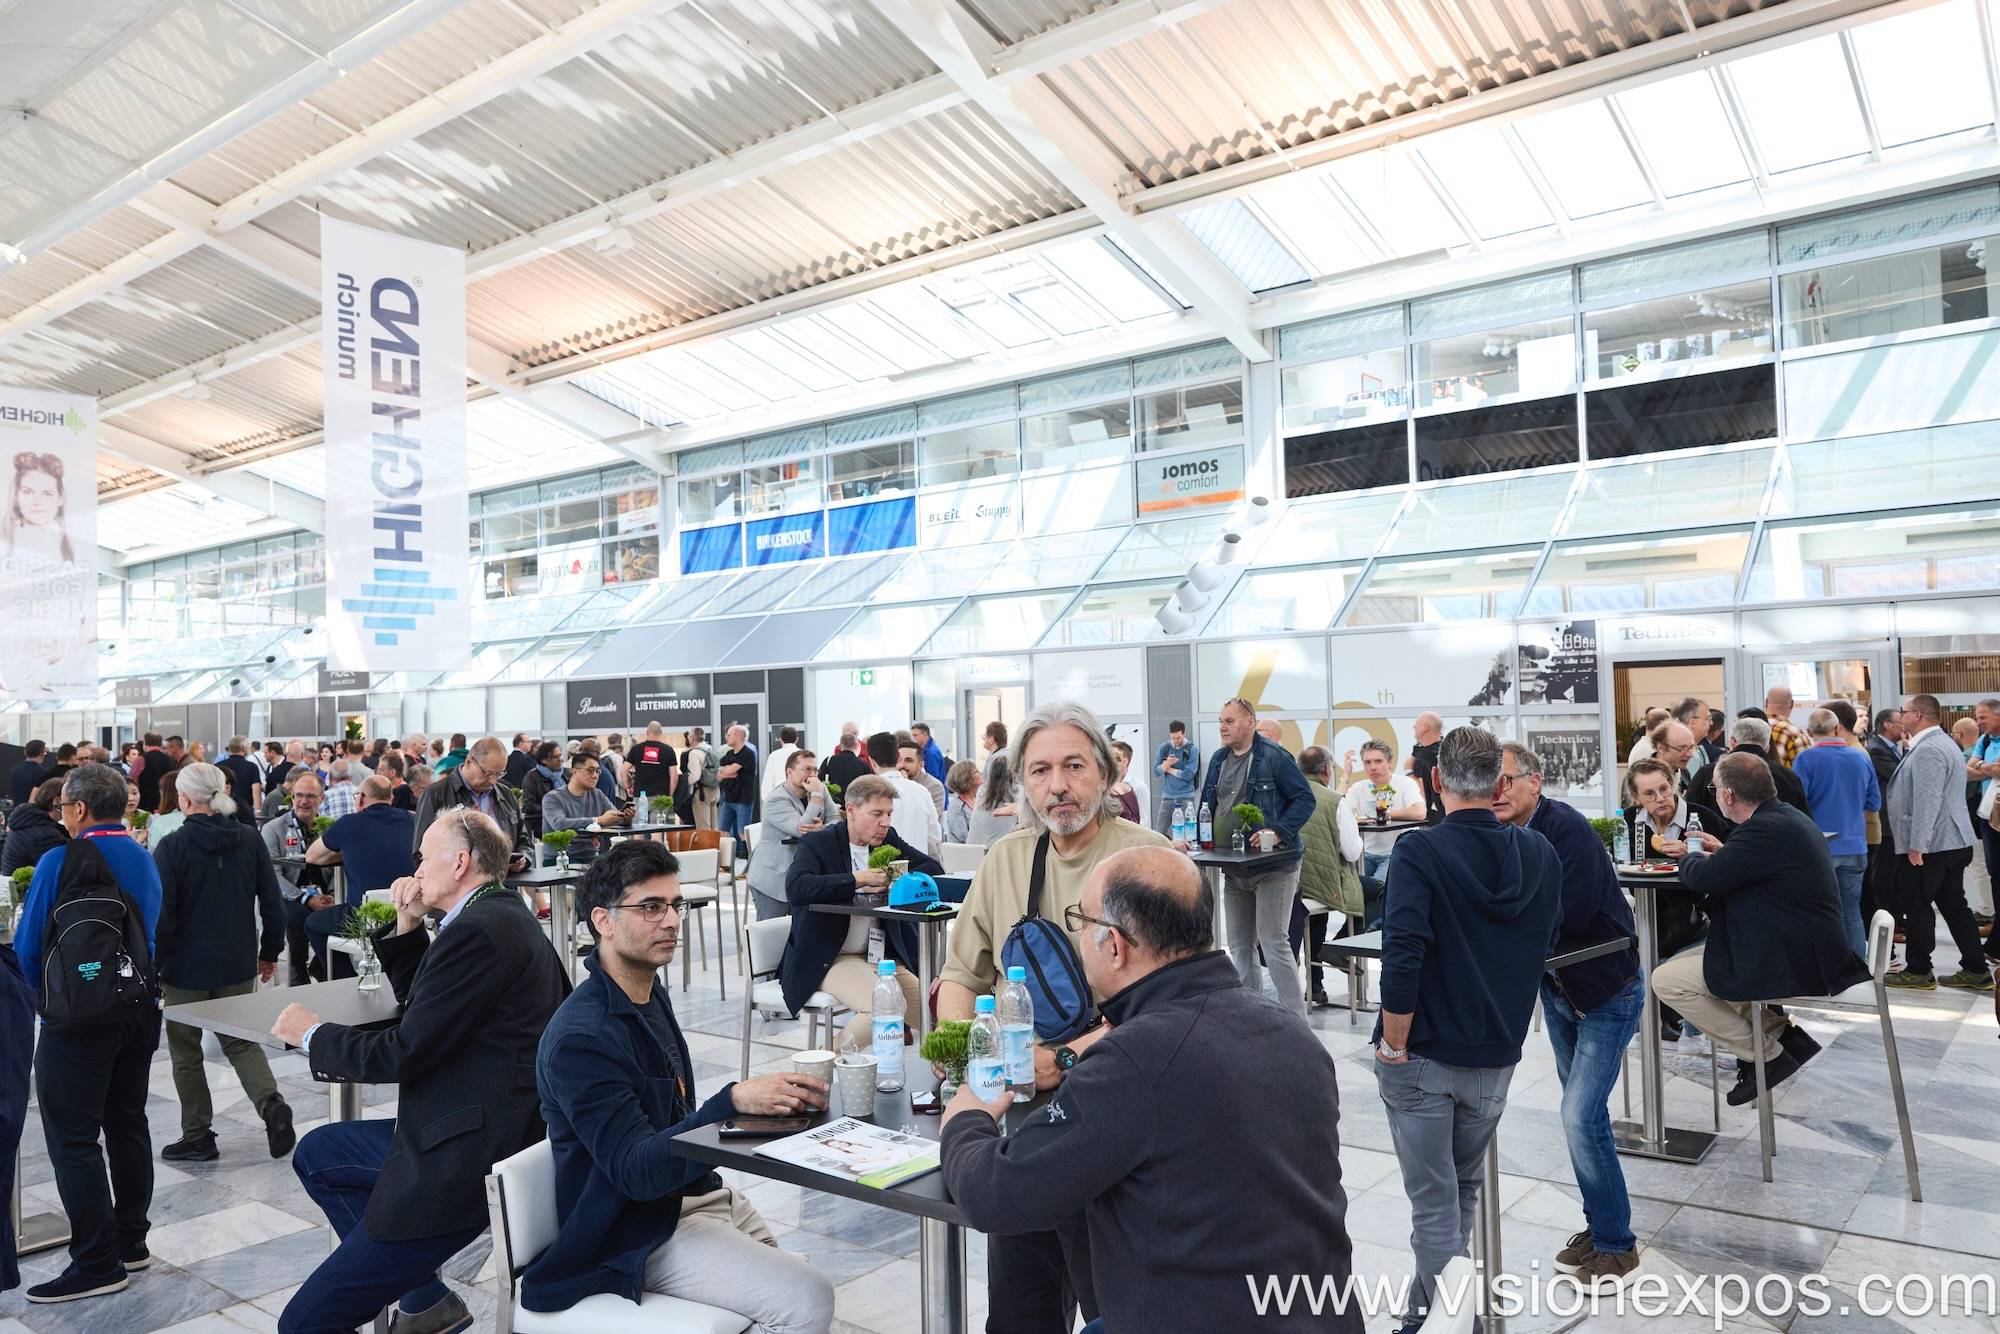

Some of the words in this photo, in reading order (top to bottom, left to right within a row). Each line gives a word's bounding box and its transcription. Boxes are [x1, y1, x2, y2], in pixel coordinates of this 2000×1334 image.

[1177, 473, 1219, 492] comfort
[756, 528, 813, 551] BIRKENSTOCK
[1618, 624, 1717, 641] Technics
[117, 687, 149, 697] MOON
[1377, 688, 1395, 705] th
[577, 697, 617, 715] Burmester
[635, 700, 679, 711] LISTENING
[680, 698, 706, 710] ROOM
[1537, 734, 1593, 745] Technics
[78, 961, 102, 972] ESS
